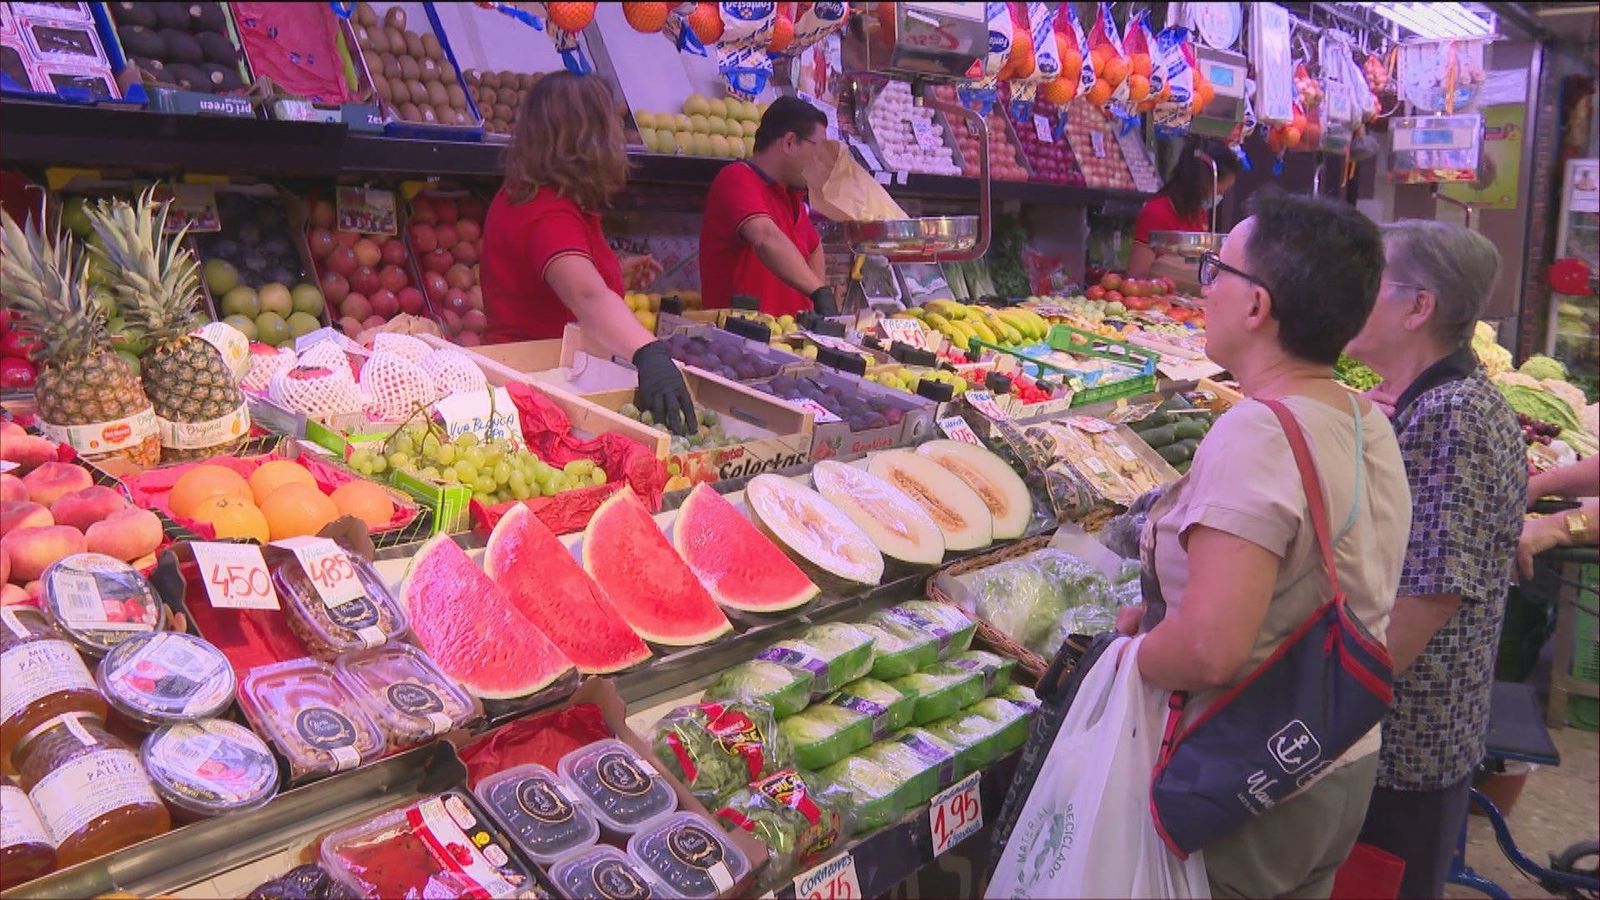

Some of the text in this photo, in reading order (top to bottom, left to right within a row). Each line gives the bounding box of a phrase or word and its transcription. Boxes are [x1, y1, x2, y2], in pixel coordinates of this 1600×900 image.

[199, 100, 234, 114] Green
[934, 787, 979, 850] 1.95
[1016, 807, 1048, 863] MATERIAL
[1048, 803, 1075, 879] RECICLADO
[800, 855, 853, 897] CORAZONES
